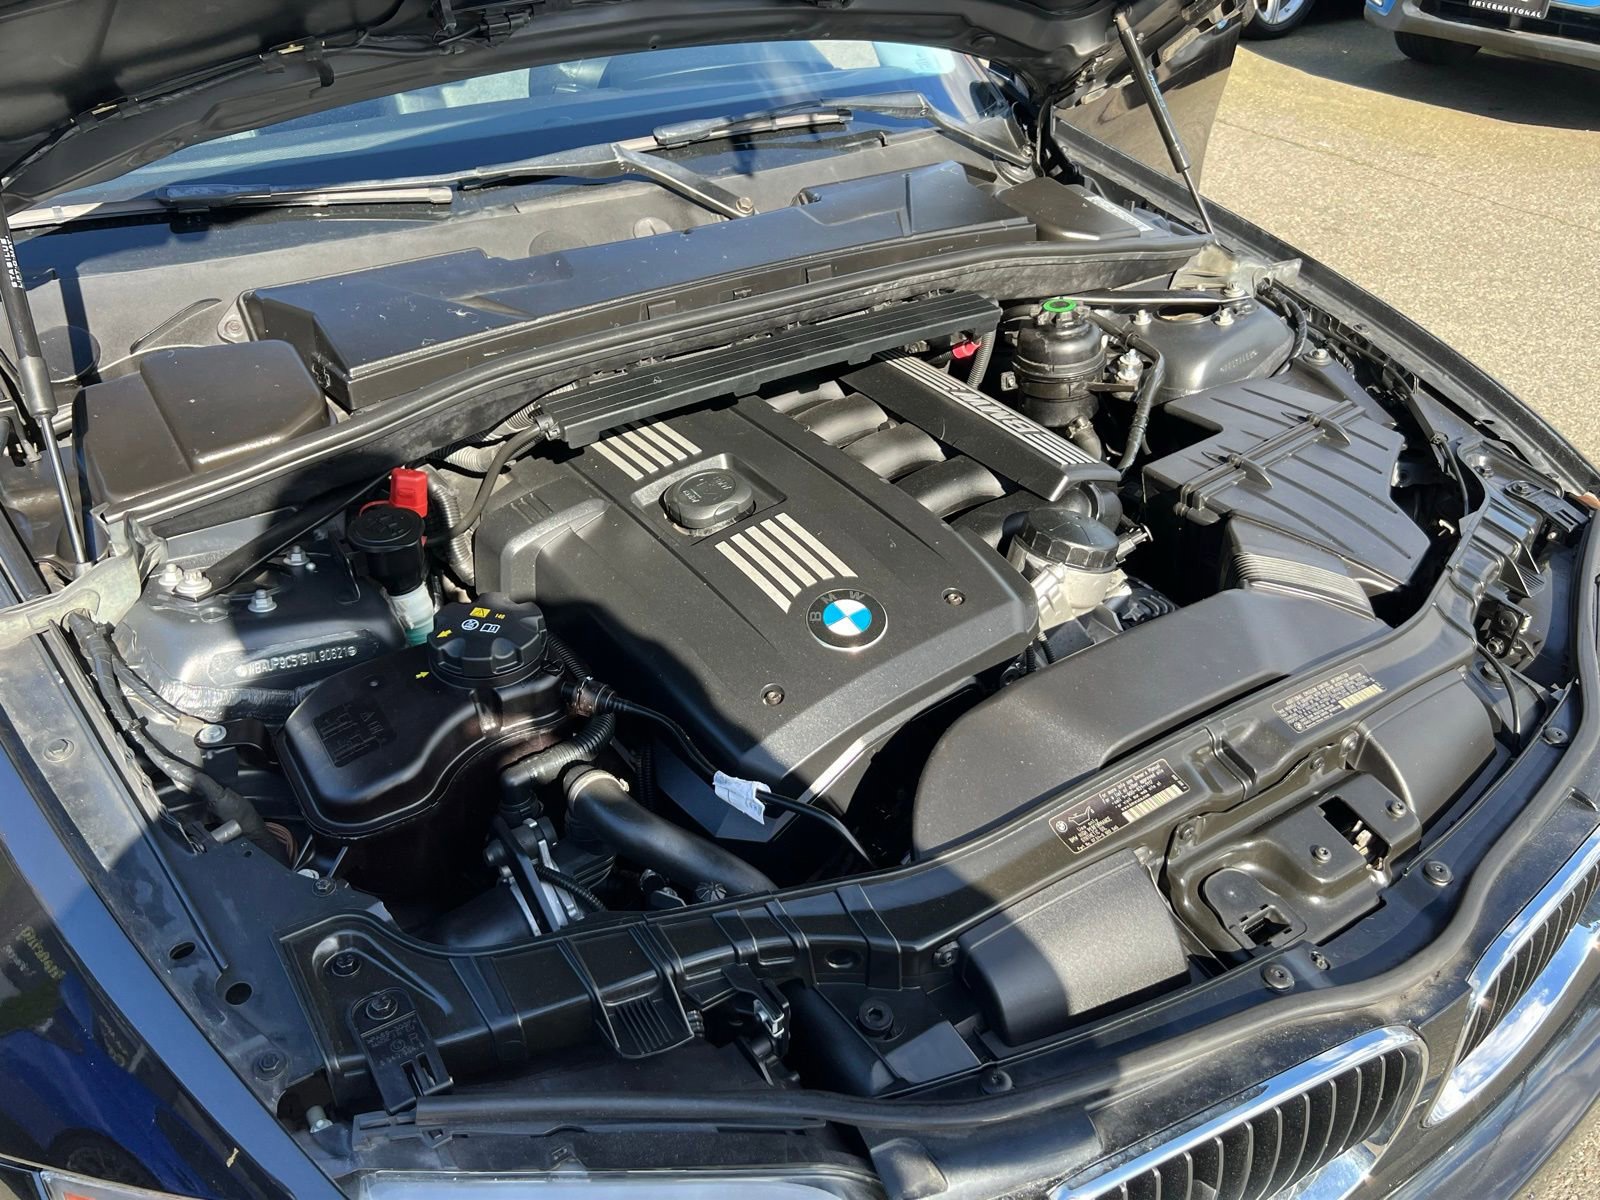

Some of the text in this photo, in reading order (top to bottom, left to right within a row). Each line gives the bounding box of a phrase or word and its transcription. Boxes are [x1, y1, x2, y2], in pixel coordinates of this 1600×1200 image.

[1471, 0, 1541, 18] INTERNATIONAL
[0, 238, 18, 288] STABILUS
[809, 590, 865, 622] BMW
